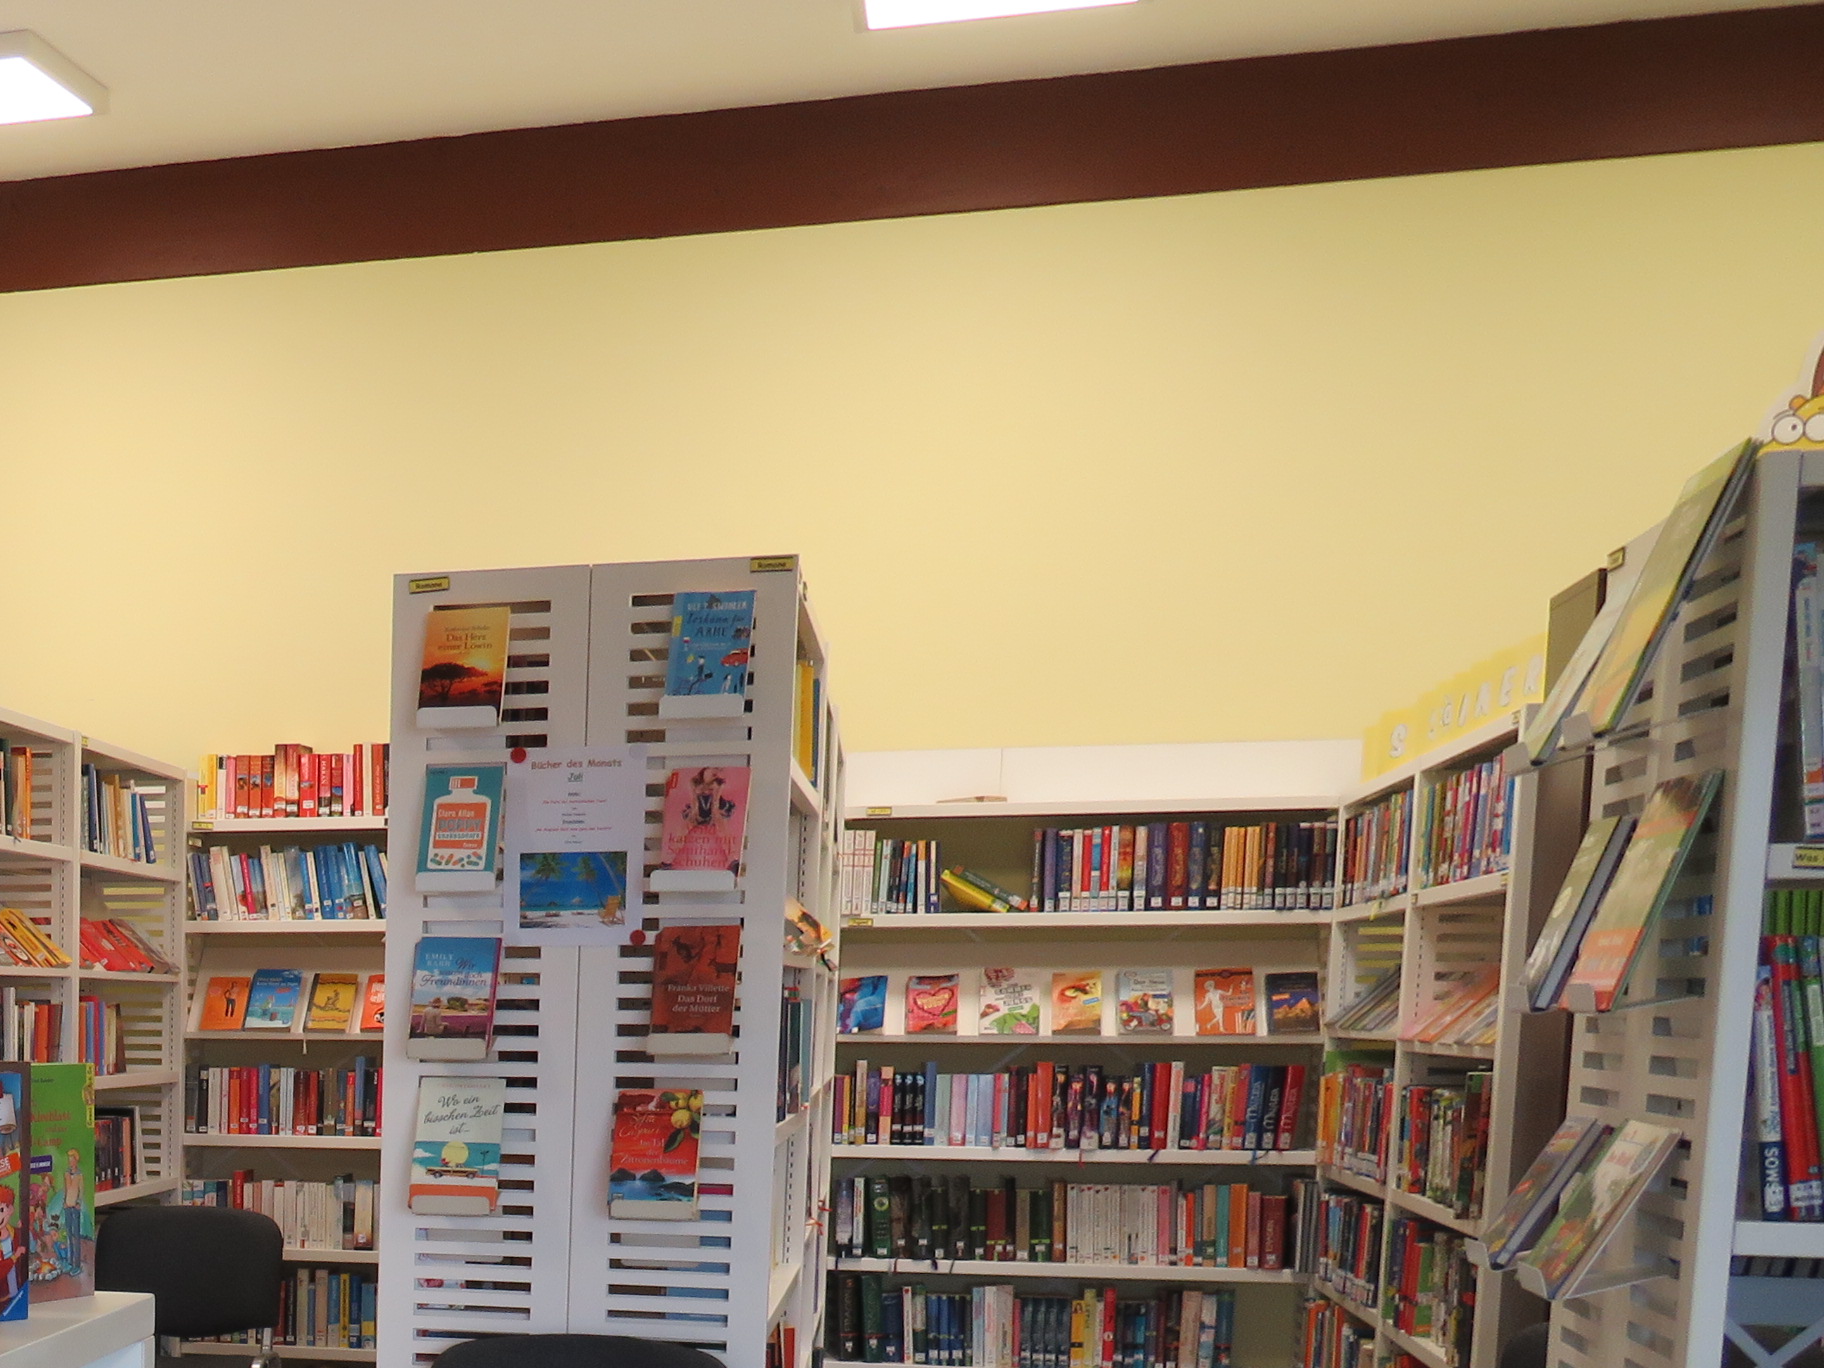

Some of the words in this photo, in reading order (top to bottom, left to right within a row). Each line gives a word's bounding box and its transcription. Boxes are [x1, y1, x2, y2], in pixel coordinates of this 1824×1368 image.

[531, 759, 562, 770] Bücher
[566, 759, 583, 768] des
[587, 758, 623, 768] Monats
[677, 994, 695, 1003] Das
[672, 1004, 687, 1012] der
